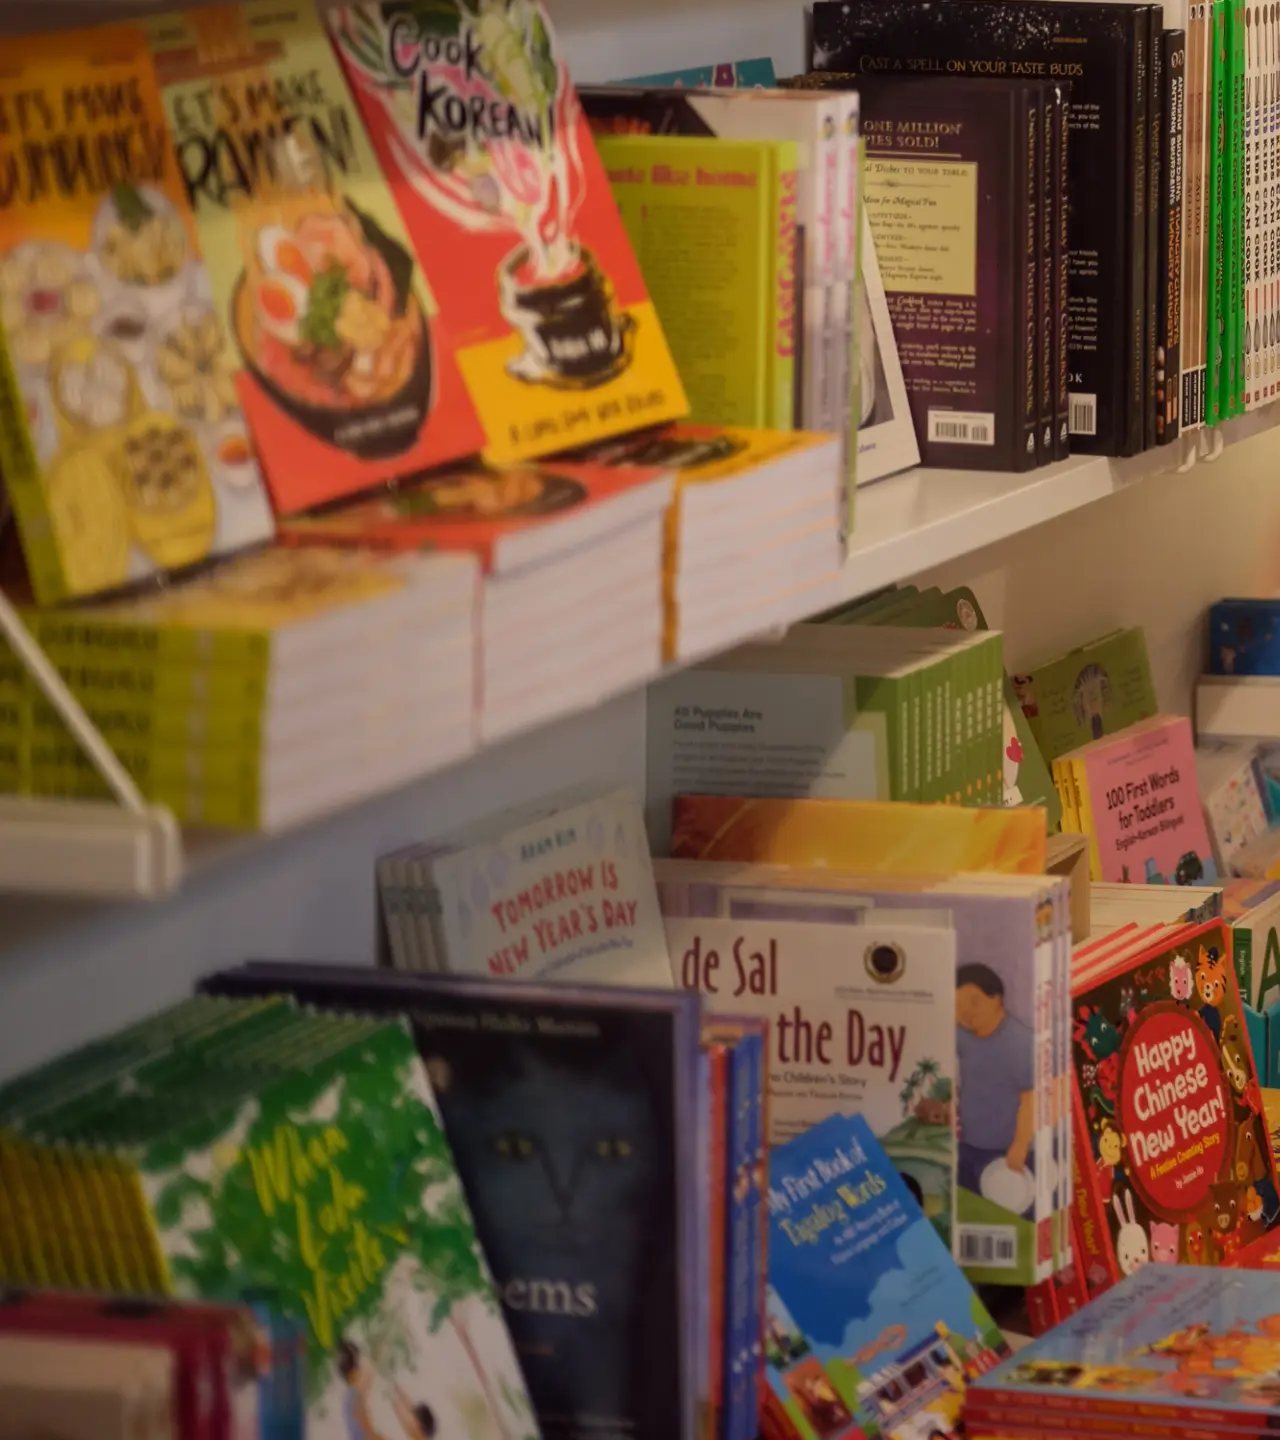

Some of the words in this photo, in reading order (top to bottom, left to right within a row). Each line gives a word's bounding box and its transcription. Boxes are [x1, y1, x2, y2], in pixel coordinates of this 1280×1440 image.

[389, 13, 493, 82] Cook
[859, 55, 891, 74] CAST
[893, 59, 901, 71] A
[905, 59, 943, 72] SPELL
[946, 60, 966, 72] ON
[969, 61, 1006, 74] YOUR
[1011, 61, 1045, 74] TASTE
[1050, 63, 1084, 76] BUDS
[417, 71, 556, 162] KOREAN!
[863, 120, 893, 133] ONE
[896, 121, 962, 135] MILLION
[863, 134, 893, 147] PIES
[897, 134, 940, 148] SOLD!
[1105, 785, 1125, 810] 100
[1125, 779, 1149, 802] First
[1148, 765, 1180, 792] Words
[1118, 809, 1134, 831] for
[1133, 796, 1175, 824] Toddlers
[491, 863, 594, 933] TOMORROW
[600, 860, 619, 891] IS
[487, 934, 530, 975] NEW
[532, 902, 599, 953] YEAR'S
[601, 899, 638, 930] DAY
[682, 936, 720, 994] de
[732, 936, 778, 998] Sal
[777, 1006, 833, 1066] the
[847, 1008, 907, 1084] Day
[1133, 1027, 1196, 1078] Happy
[1133, 1062, 1208, 1121] Chinese
[1129, 1122, 1176, 1167] New
[1173, 1085, 1226, 1141] Year!
[1177, 1143, 1204, 1167] Counting
[1202, 1132, 1221, 1149] Story
[503, 1275, 599, 1317] ems
